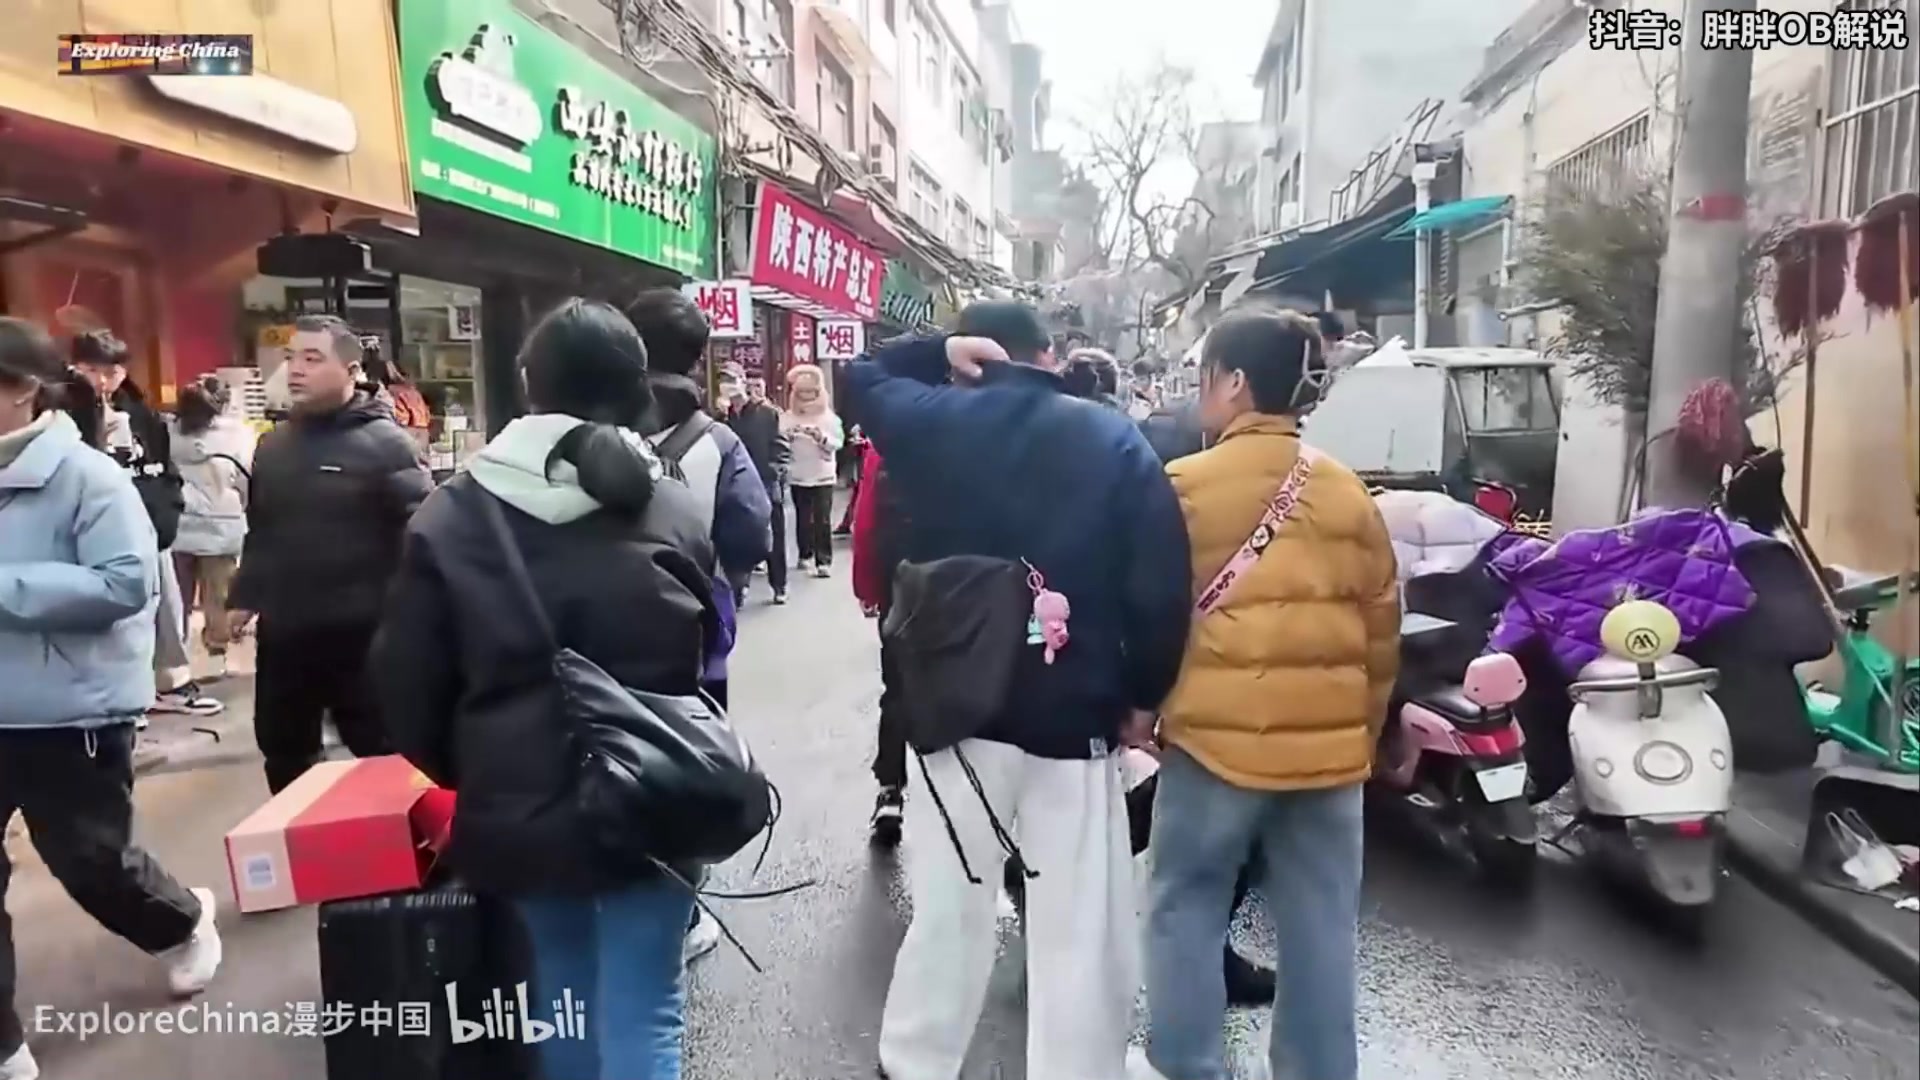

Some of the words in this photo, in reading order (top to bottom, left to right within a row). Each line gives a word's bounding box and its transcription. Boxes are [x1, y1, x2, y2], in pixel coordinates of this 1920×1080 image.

[769, 201, 875, 306] 陕西特产总汇
[694, 286, 740, 331] 烟
[825, 325, 855, 355] 烟
